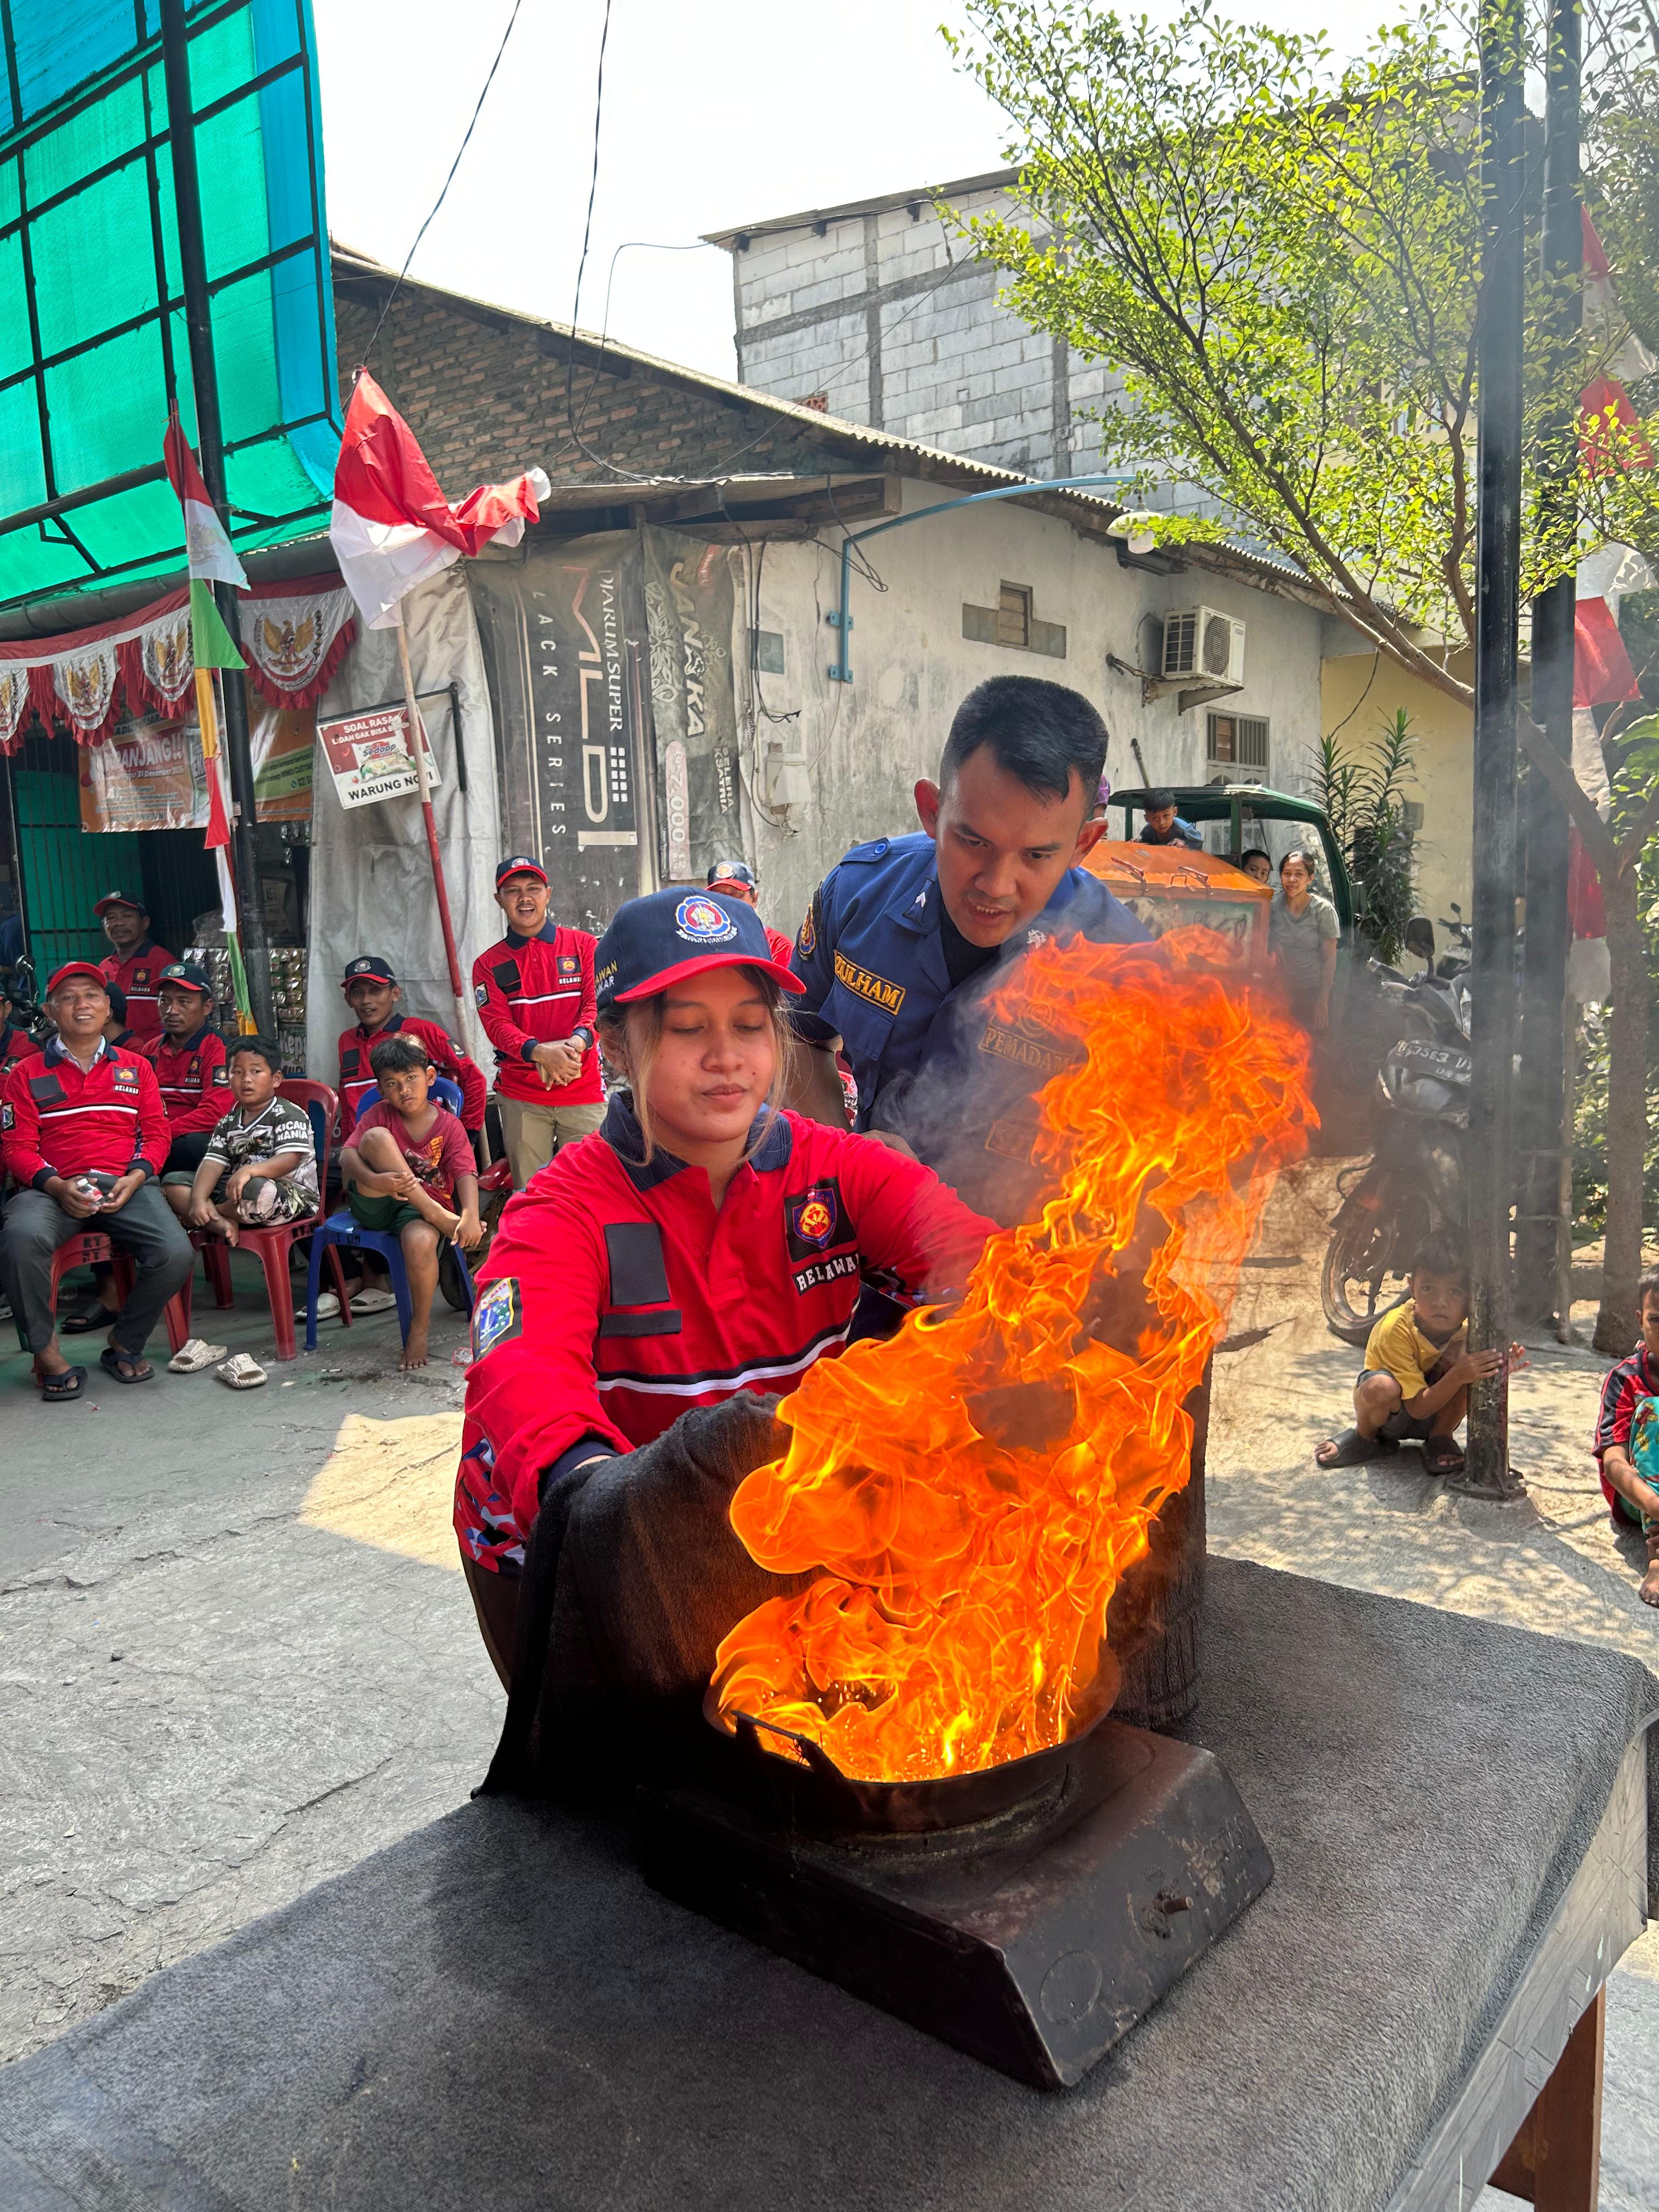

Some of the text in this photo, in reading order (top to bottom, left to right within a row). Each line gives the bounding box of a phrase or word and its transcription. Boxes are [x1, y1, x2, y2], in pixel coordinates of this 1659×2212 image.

[597, 569, 623, 732] DJARUM SUPER
[561, 566, 608, 823] MLD
[343, 721, 370, 734] SOAL
[532, 591, 567, 834] LACK SERIES
[331, 733, 355, 746] LDAH
[356, 731, 371, 741] GAK
[370, 727, 388, 737] BISA
[363, 743, 397, 757] Sedaap
[348, 771, 433, 801] WARUNG NOI
[714, 747, 728, 815] KSATRIA
[596, 960, 618, 986] AWAN
[835, 955, 900, 1008] ZULHAM
[114, 1084, 139, 1094] RELAWAN
